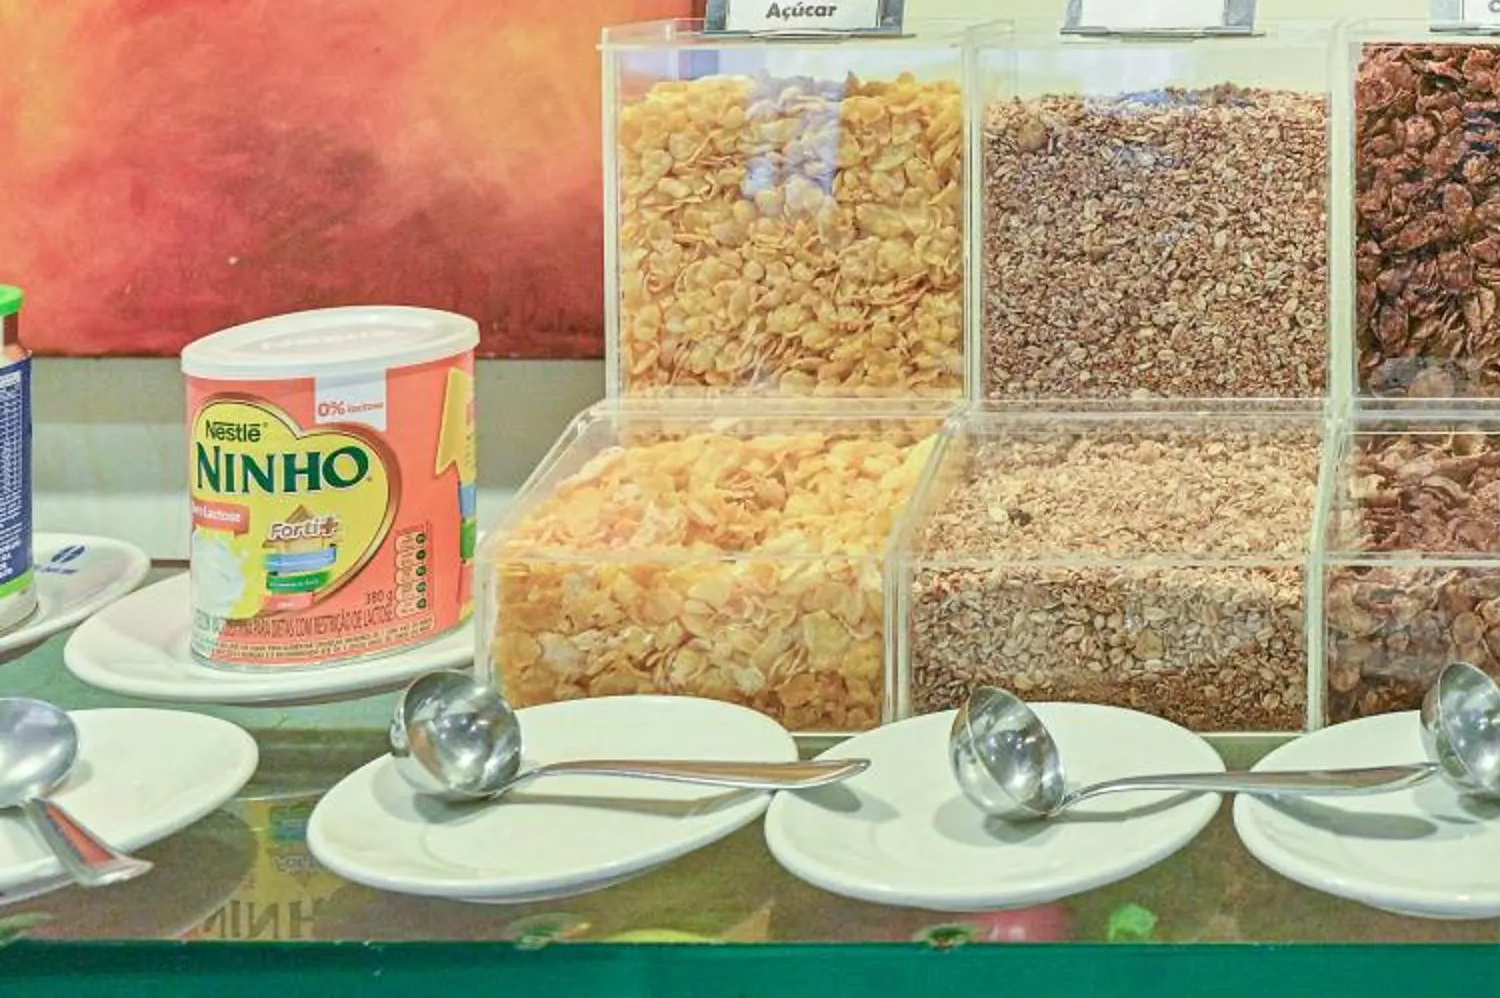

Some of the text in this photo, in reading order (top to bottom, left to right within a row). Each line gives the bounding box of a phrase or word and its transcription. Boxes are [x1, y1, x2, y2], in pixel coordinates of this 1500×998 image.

[765, 2, 837, 21] Açúcar
[318, 401, 346, 417] 0%
[196, 442, 369, 493] NINHO
